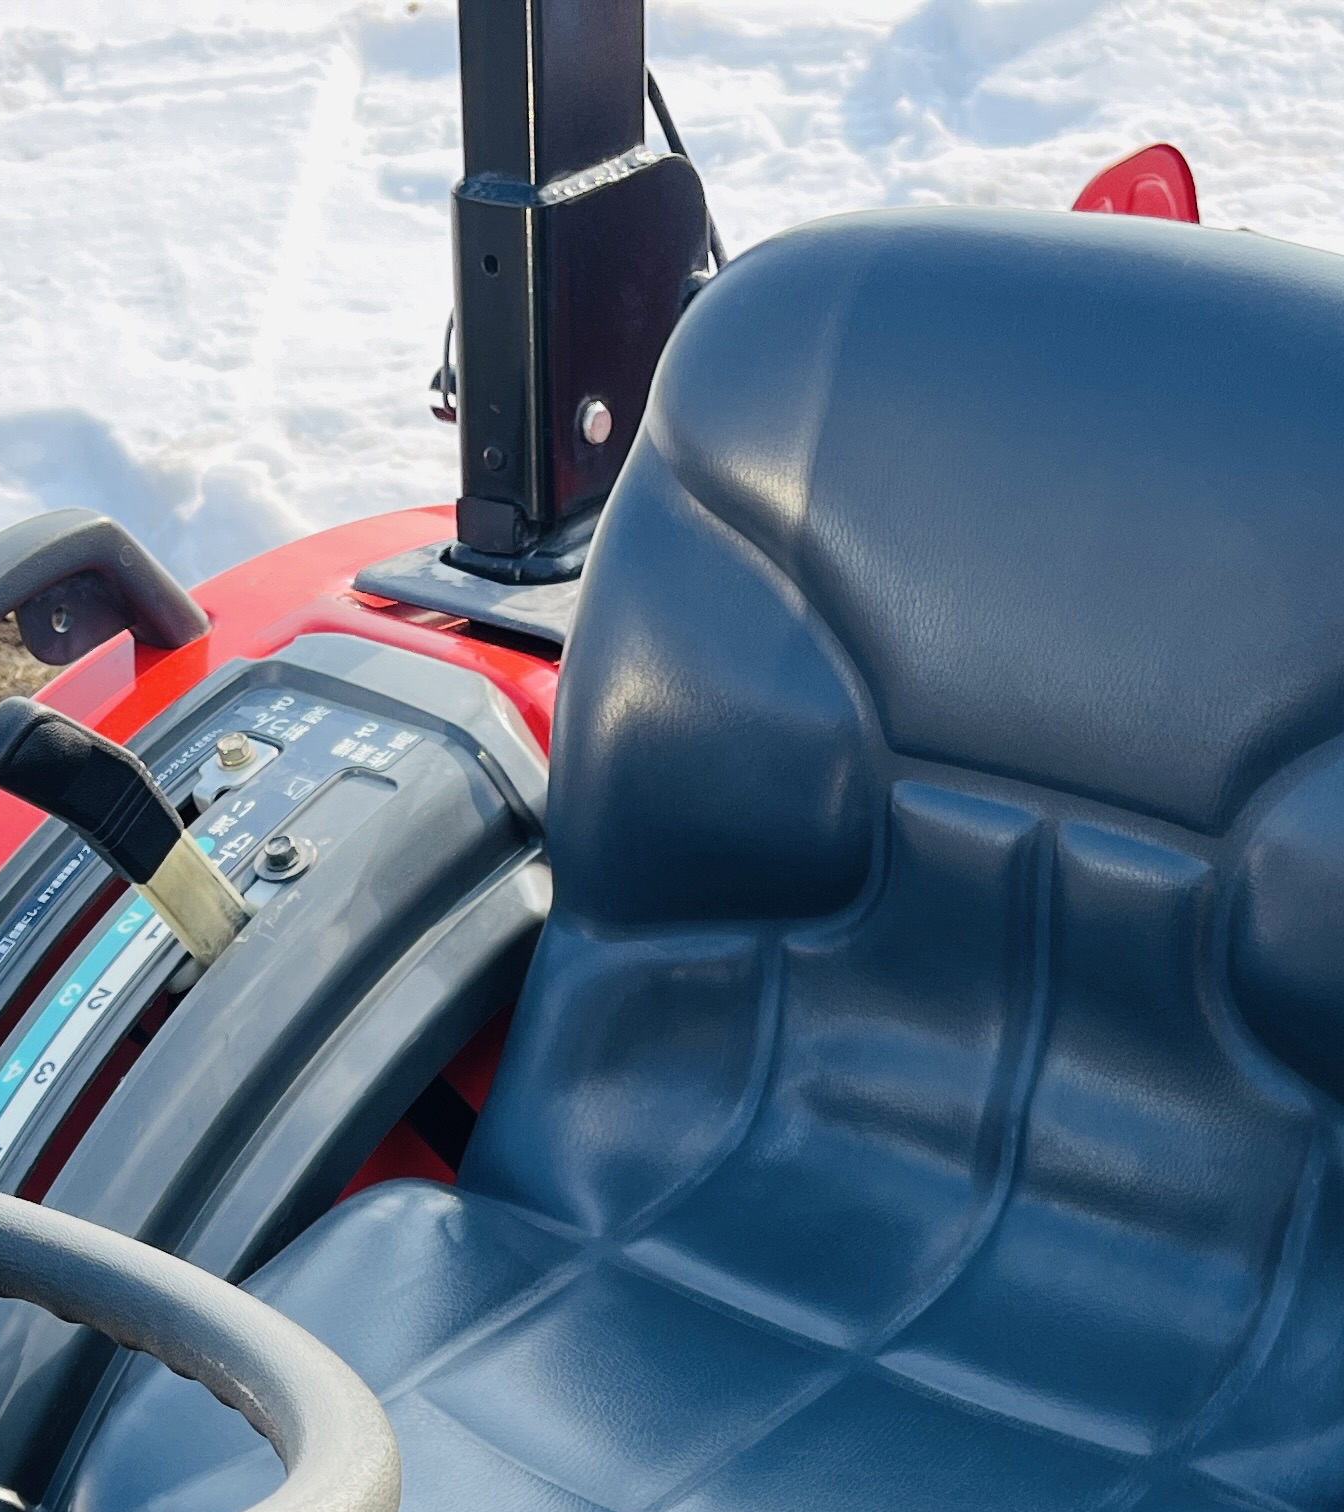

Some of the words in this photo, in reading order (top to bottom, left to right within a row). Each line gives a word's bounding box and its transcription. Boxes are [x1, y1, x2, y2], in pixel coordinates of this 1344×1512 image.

[59, 982, 83, 1007] 3
[87, 987, 112, 1011] 2
[1, 1059, 25, 1083] 4
[33, 1061, 56, 1084] 3
